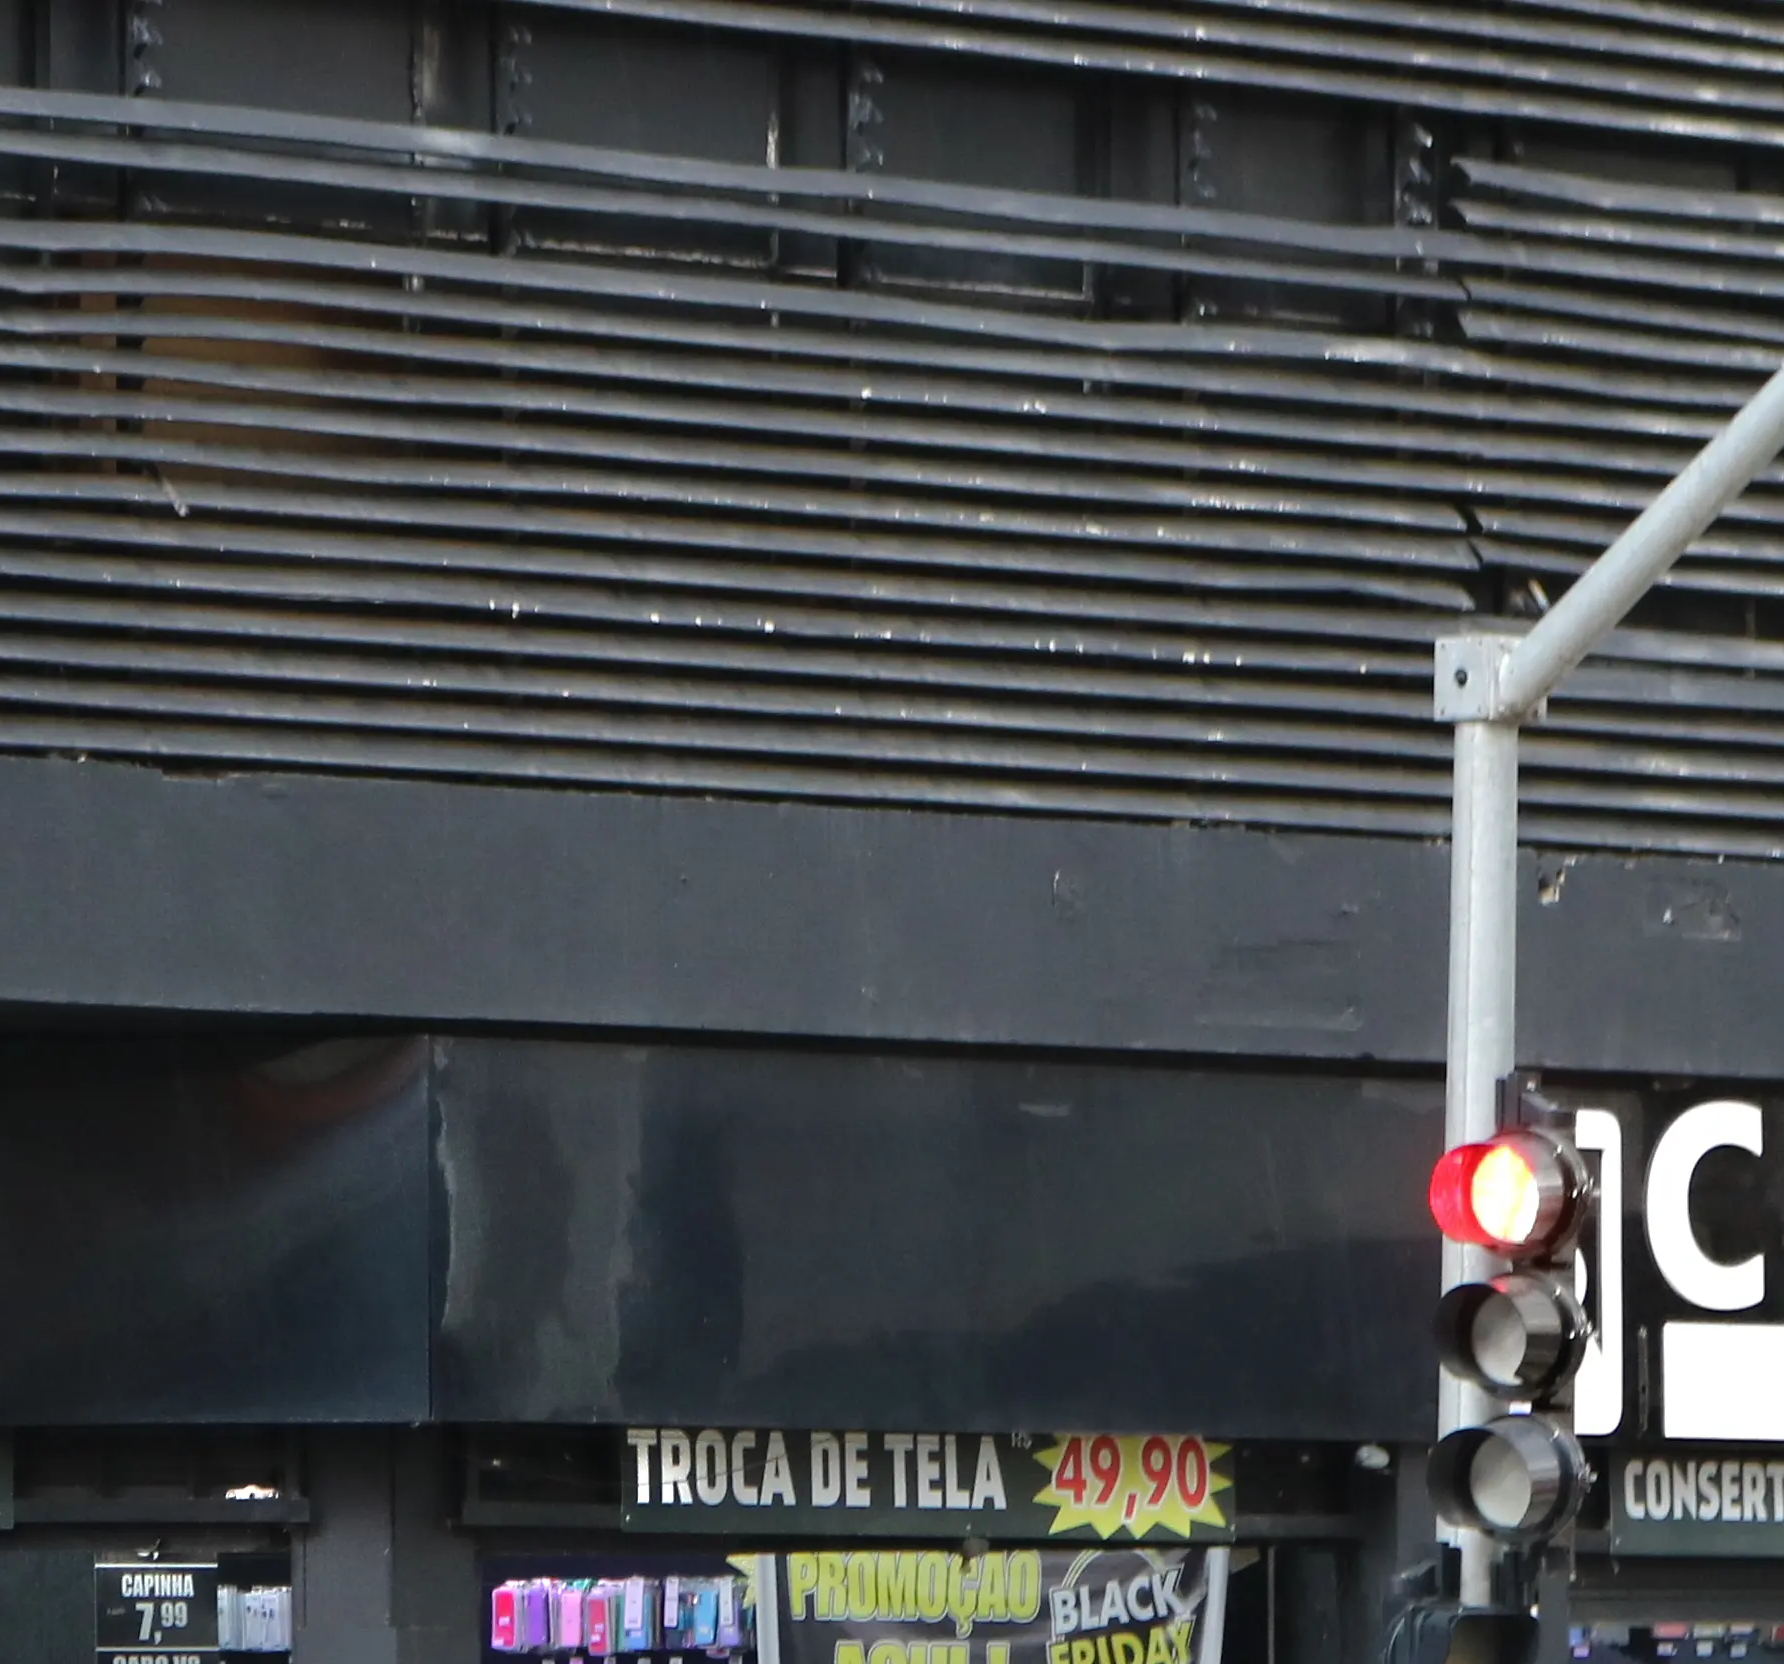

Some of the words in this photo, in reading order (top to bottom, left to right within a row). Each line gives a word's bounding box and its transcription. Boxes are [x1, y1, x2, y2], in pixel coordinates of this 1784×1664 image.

[627, 1430, 794, 1505] TROCA
[811, 1433, 875, 1508] DE
[884, 1435, 1007, 1511] TELA
[1055, 1435, 1208, 1519] 49,90
[121, 1573, 195, 1597] CAPINHA
[1049, 1565, 1184, 1634] BLACK
[135, 1602, 188, 1645] 7,99
